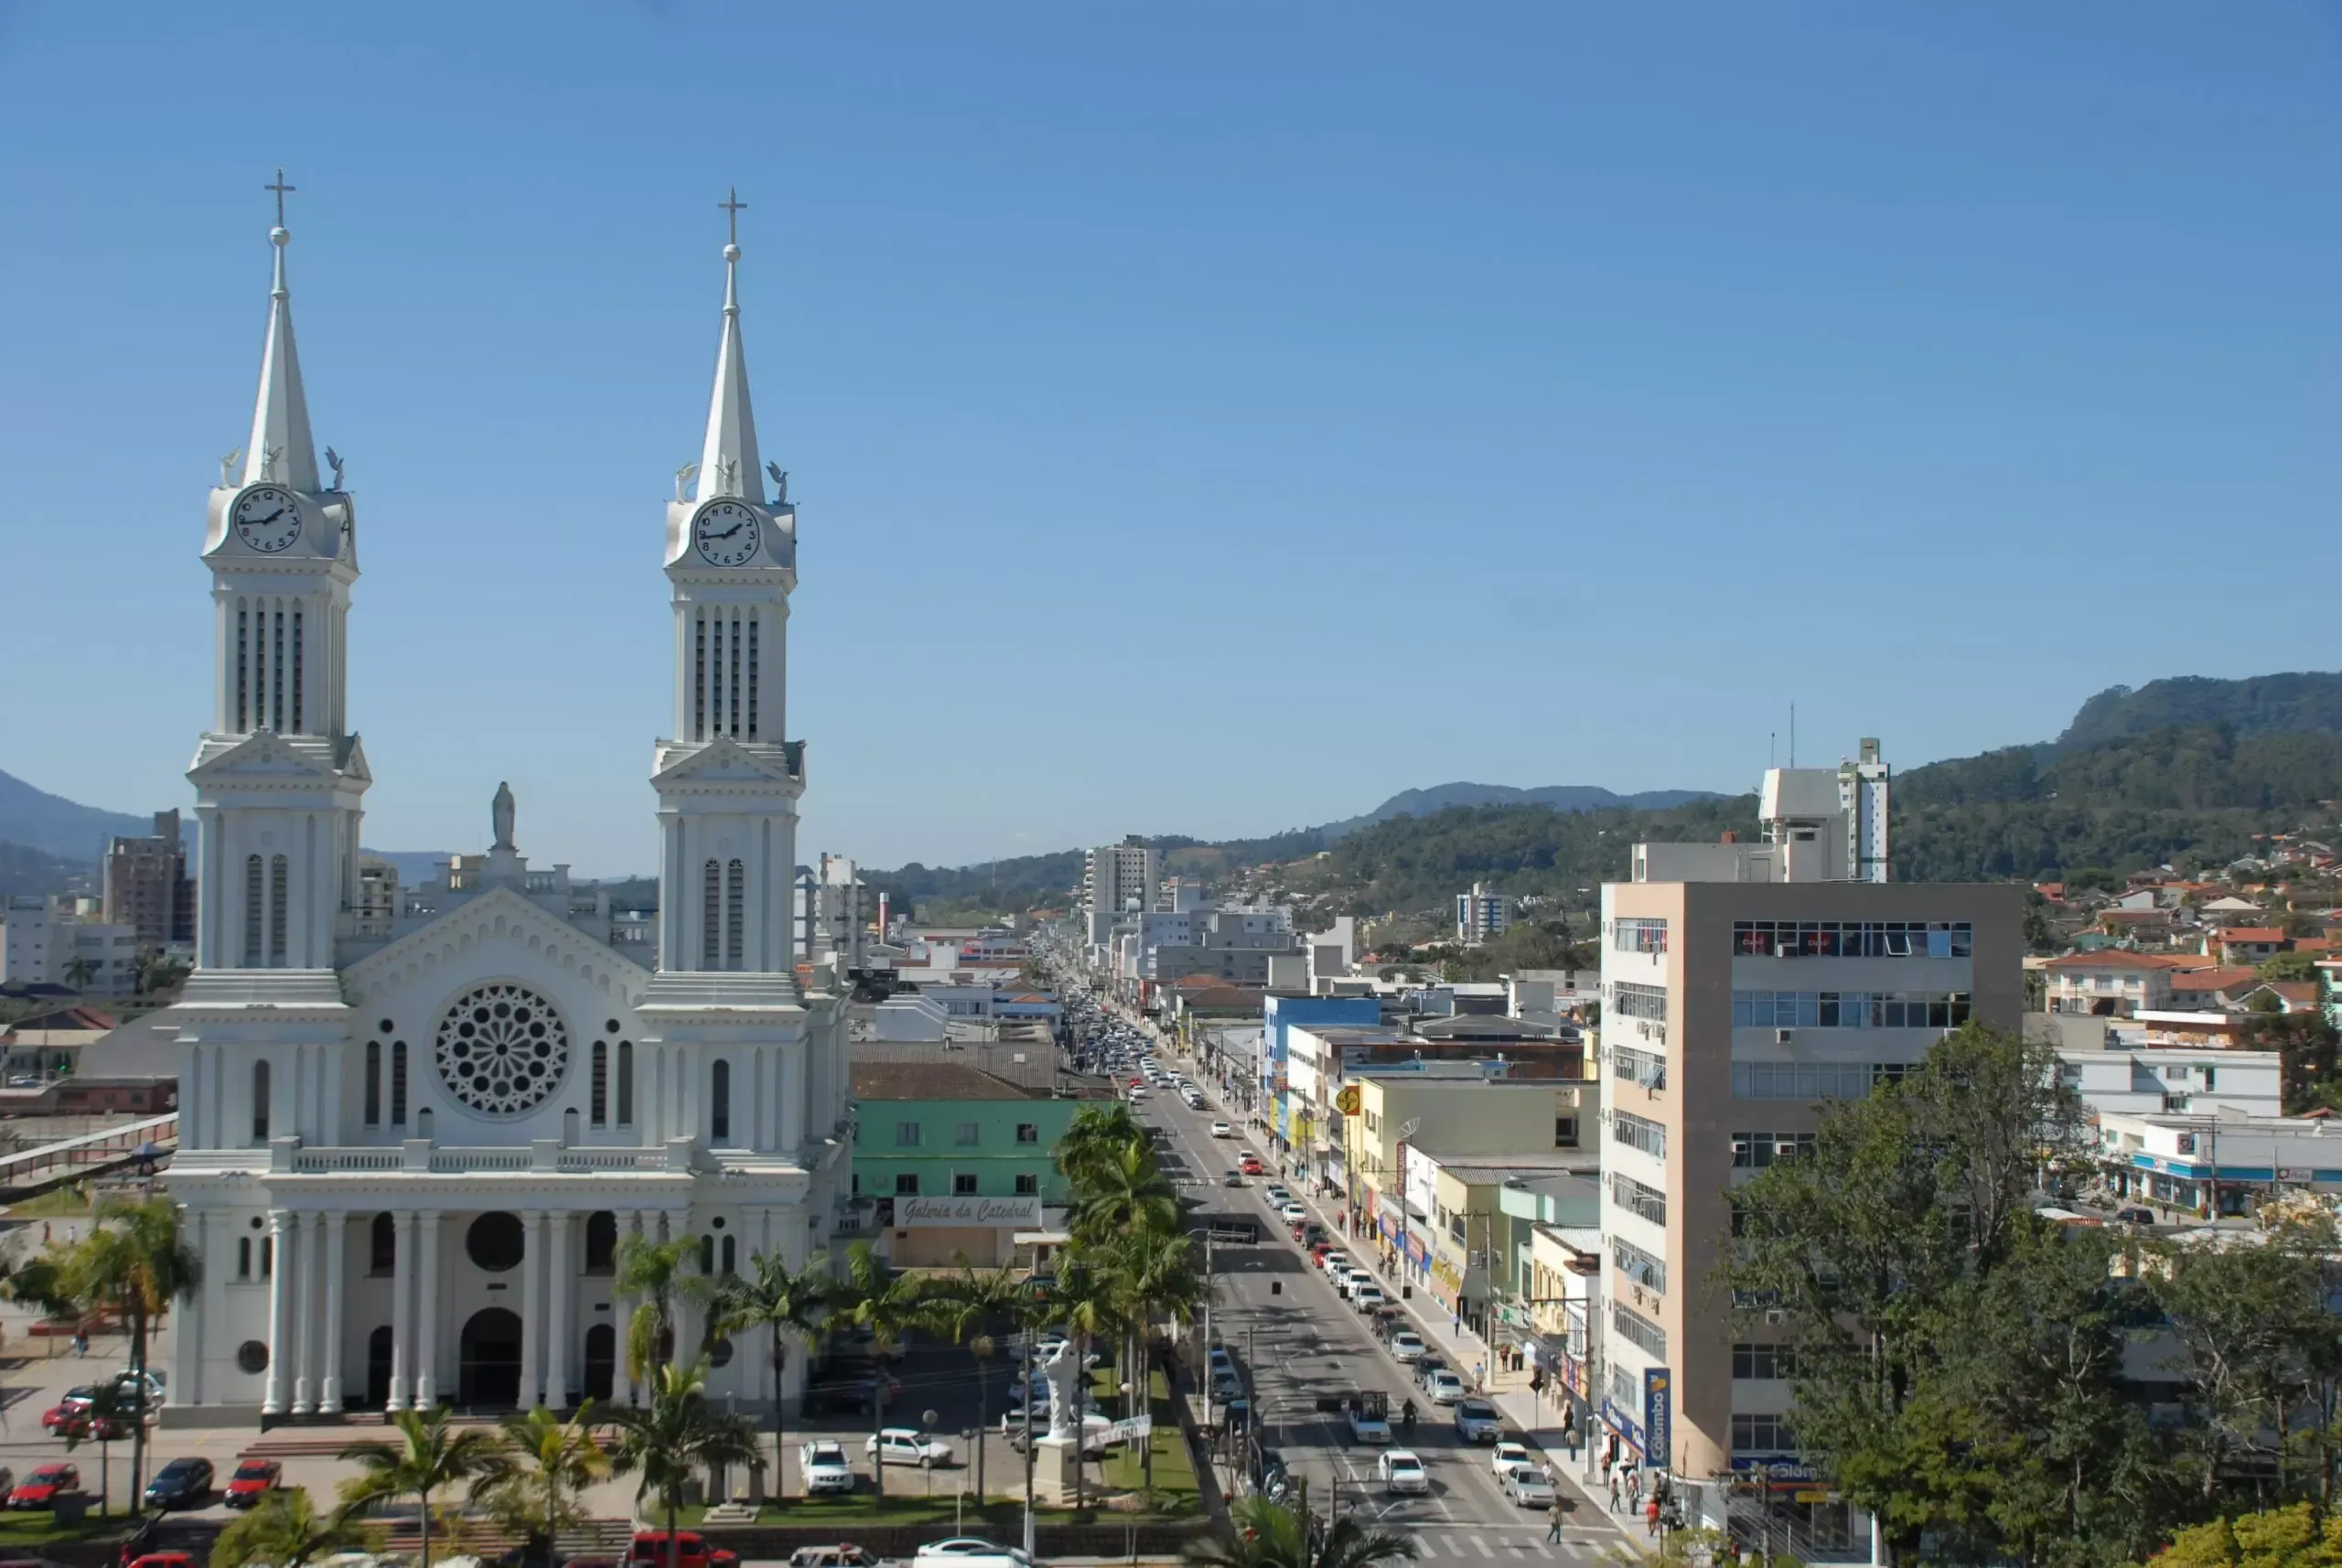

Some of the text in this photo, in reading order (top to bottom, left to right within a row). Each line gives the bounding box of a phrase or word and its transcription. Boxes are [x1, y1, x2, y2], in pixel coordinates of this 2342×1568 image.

[252, 495, 260, 503] 11
[263, 491, 274, 500] 12
[278, 496, 284, 505] 1
[242, 502, 252, 511] 10
[288, 504, 295, 512] 2
[723, 505, 732, 514] 12
[711, 509, 718, 517] 11
[737, 510, 742, 519] 1
[238, 515, 245, 524] 9
[292, 516, 299, 525] 3
[702, 518, 711, 526] 10
[746, 518, 753, 527] 2
[242, 527, 250, 537] 8
[286, 530, 295, 538] 4
[699, 530, 706, 540] 9
[748, 531, 756, 540] 3
[252, 538, 260, 546] 7
[264, 542, 273, 550] 6
[277, 538, 285, 547] 5
[703, 542, 709, 552] 8
[713, 553, 719, 561] 7
[724, 555, 731, 564] 6
[736, 553, 744, 561] 5
[904, 1198, 951, 1224] Galeria
[977, 1198, 1034, 1222] Catedral
[1651, 1392, 1664, 1460] Colombo
